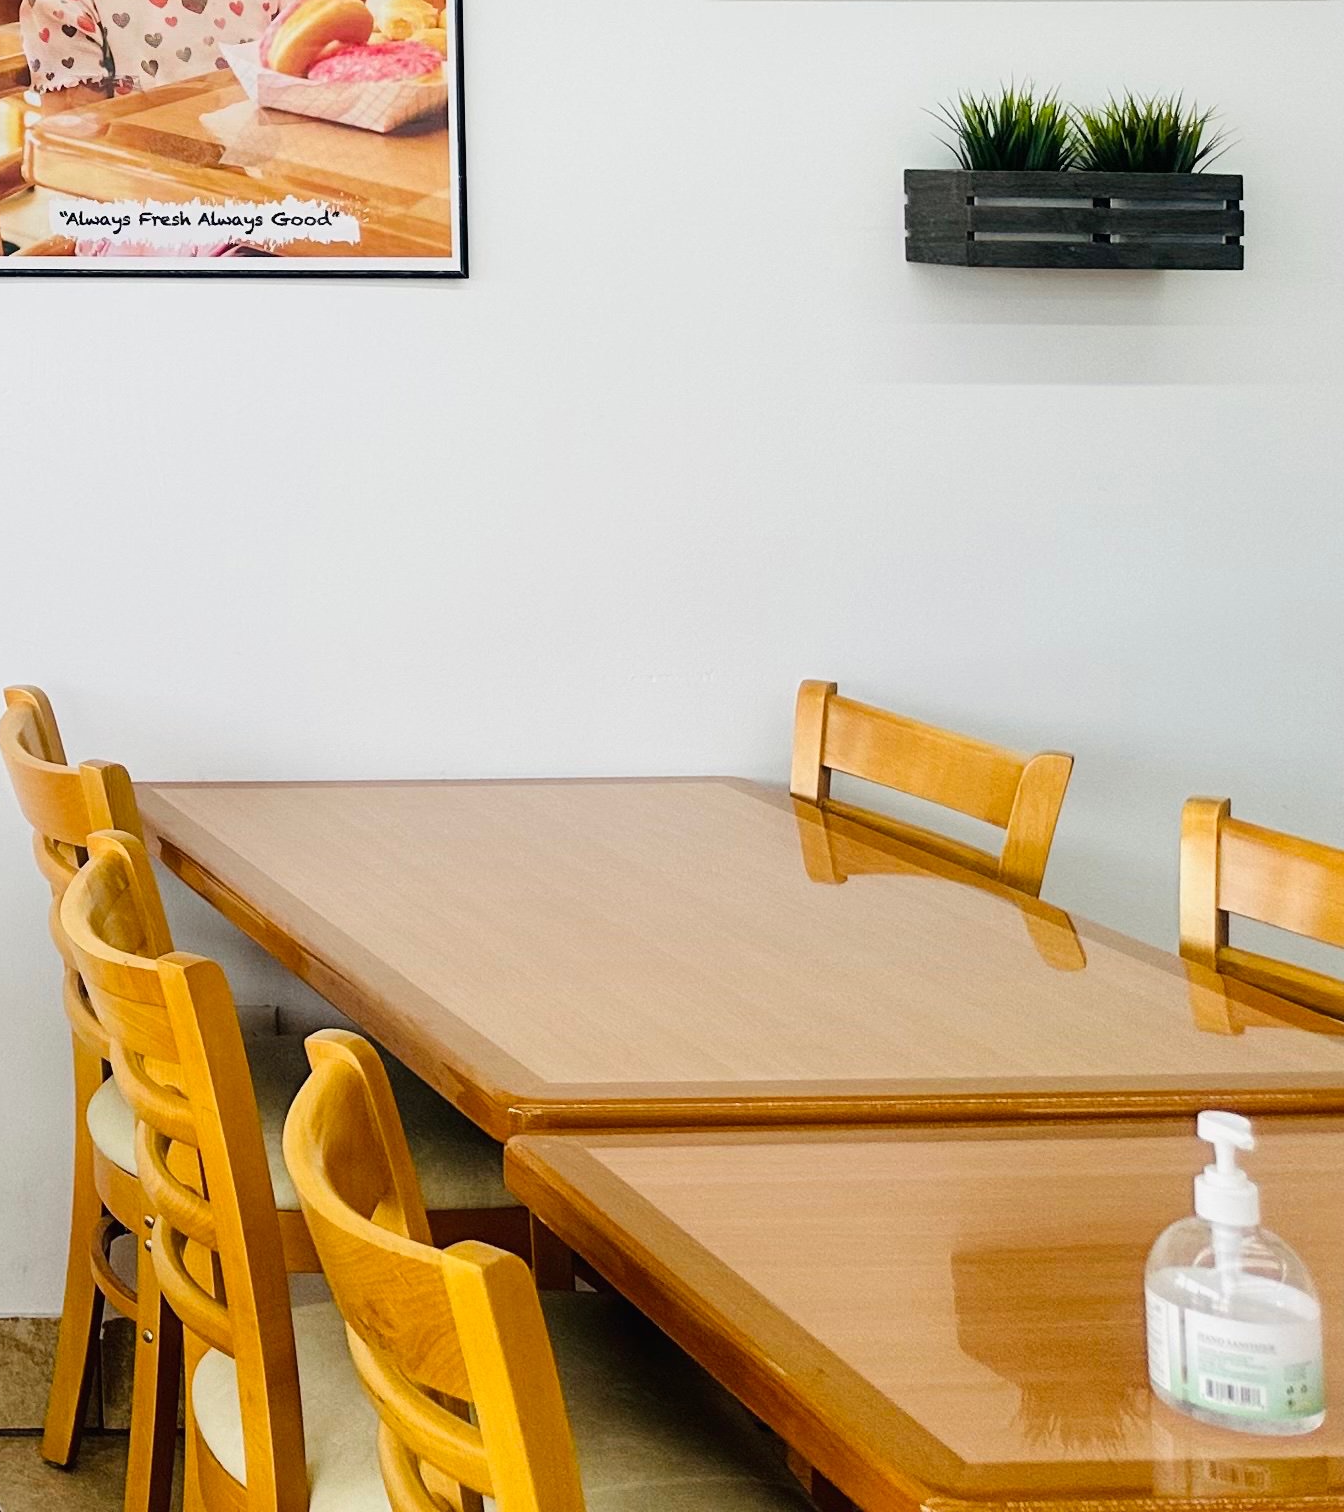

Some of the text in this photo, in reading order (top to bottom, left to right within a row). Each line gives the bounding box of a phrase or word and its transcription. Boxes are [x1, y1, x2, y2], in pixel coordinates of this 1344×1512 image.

[59, 211, 340, 235] "Always Fresh Always Good"
